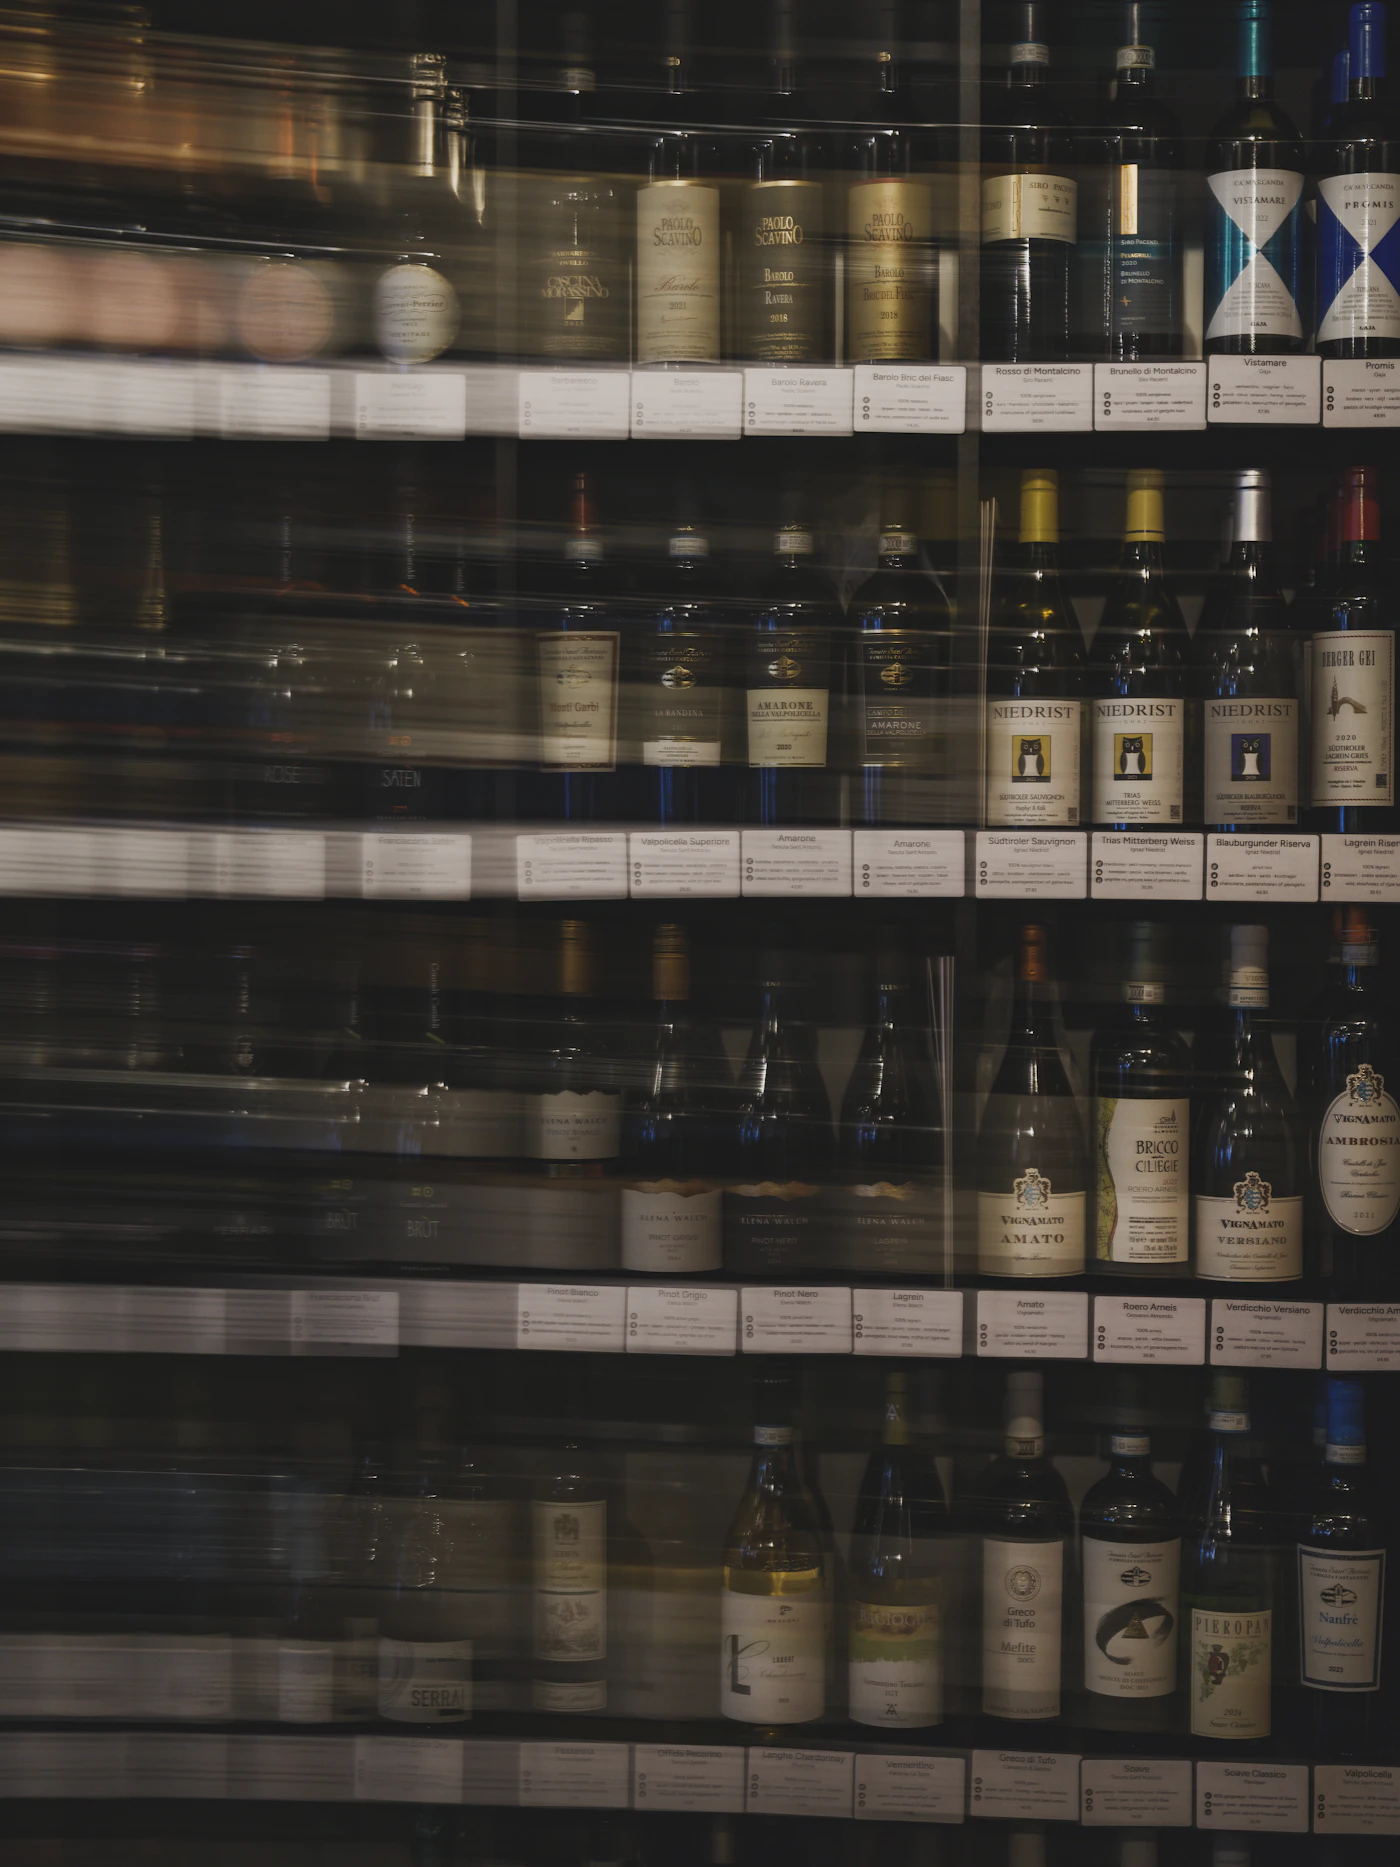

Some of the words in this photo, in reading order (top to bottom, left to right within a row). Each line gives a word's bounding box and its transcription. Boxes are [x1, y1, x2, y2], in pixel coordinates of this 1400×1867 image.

[763, 216, 794, 231] PAOLO
[873, 213, 903, 226] PAOLO
[661, 218, 693, 231] PAOLO
[756, 225, 803, 246] SCAVINO
[864, 222, 913, 242] SCAVINO
[653, 227, 702, 247] SCAVINO
[764, 268, 794, 281] BAROLO
[874, 265, 905, 278] BAROLO
[654, 274, 700, 292] Barolo
[765, 291, 793, 305] RAVERA
[669, 302, 687, 310] 2021
[770, 314, 788, 323] 2018
[880, 311, 898, 320] 2018
[1244, 359, 1287, 367] Vistamare
[1365, 362, 1395, 370] Promis
[1023, 367, 1032, 375] di
[1034, 367, 1081, 375] Montalcino
[1141, 367, 1151, 375] di
[1153, 367, 1197, 375] Montalcino
[873, 373, 899, 382] Barolo
[901, 373, 917, 382] Bric
[918, 373, 931, 382] del
[933, 373, 954, 382] Fiasc
[674, 378, 700, 387] Barolo
[771, 378, 797, 387] Barolo
[799, 379, 827, 387] Ravera
[1322, 650, 1355, 668] BERGER
[1359, 650, 1376, 665] GEI
[758, 702, 813, 710] AMARONE
[1211, 704, 1293, 717] NIEDRIST
[994, 706, 1074, 719] NIEDRIST
[1097, 704, 1176, 718] NIEDRIST
[1328, 744, 1366, 752] SÜDTIROLER
[581, 836, 613, 844] Ripasso
[641, 838, 687, 846] Valpolicella
[689, 838, 730, 846] Superiore
[778, 834, 816, 843] Amarone
[988, 836, 1029, 845] Südtiroler
[1031, 838, 1076, 847] Sauvignon
[1102, 836, 1121, 844] Trias
[1123, 837, 1169, 846] Mitterberg
[894, 840, 931, 848] Amarone
[1216, 839, 1278, 848] Blauburgunder
[1280, 840, 1311, 848] Riserva
[1136, 1140, 1178, 1155] BRICCO
[1135, 1160, 1178, 1173] CILIEGIE
[1001, 1233, 1064, 1244] AMATO
[1218, 1236, 1287, 1245] VERSIANO
[570, 1288, 599, 1296] Bianco
[658, 1290, 680, 1298] Pinot
[682, 1290, 707, 1300] Grigio
[774, 1290, 796, 1298] Pinot
[797, 1290, 818, 1298] Nero
[893, 1292, 924, 1301] Lagrein
[1017, 1301, 1045, 1309] Amato
[1123, 1303, 1149, 1311] Roero
[1150, 1303, 1177, 1311] Arneis
[1226, 1303, 1272, 1313] Verdicchio
[1273, 1305, 1311, 1314] Versiano
[1008, 1607, 1035, 1617] Greco
[1319, 1612, 1359, 1625] Nanfrè
[1004, 1619, 1014, 1627] di
[1016, 1619, 1035, 1628] Tufo
[1195, 1616, 1269, 1635] PIEROPAN
[1001, 1641, 1036, 1652] Mefite
[685, 1750, 723, 1758] Pecorino
[762, 1751, 794, 1760] Langhe
[795, 1752, 845, 1764] Chardonnay
[999, 1753, 1026, 1763] Greco
[1037, 1757, 1056, 1765] Tufo
[886, 1760, 934, 1770] Vermentino
[1124, 1765, 1150, 1773] Soave
[1224, 1769, 1250, 1778] Soave
[1252, 1770, 1287, 1778] Classico
[1344, 1769, 1392, 1778] Valpolicella
